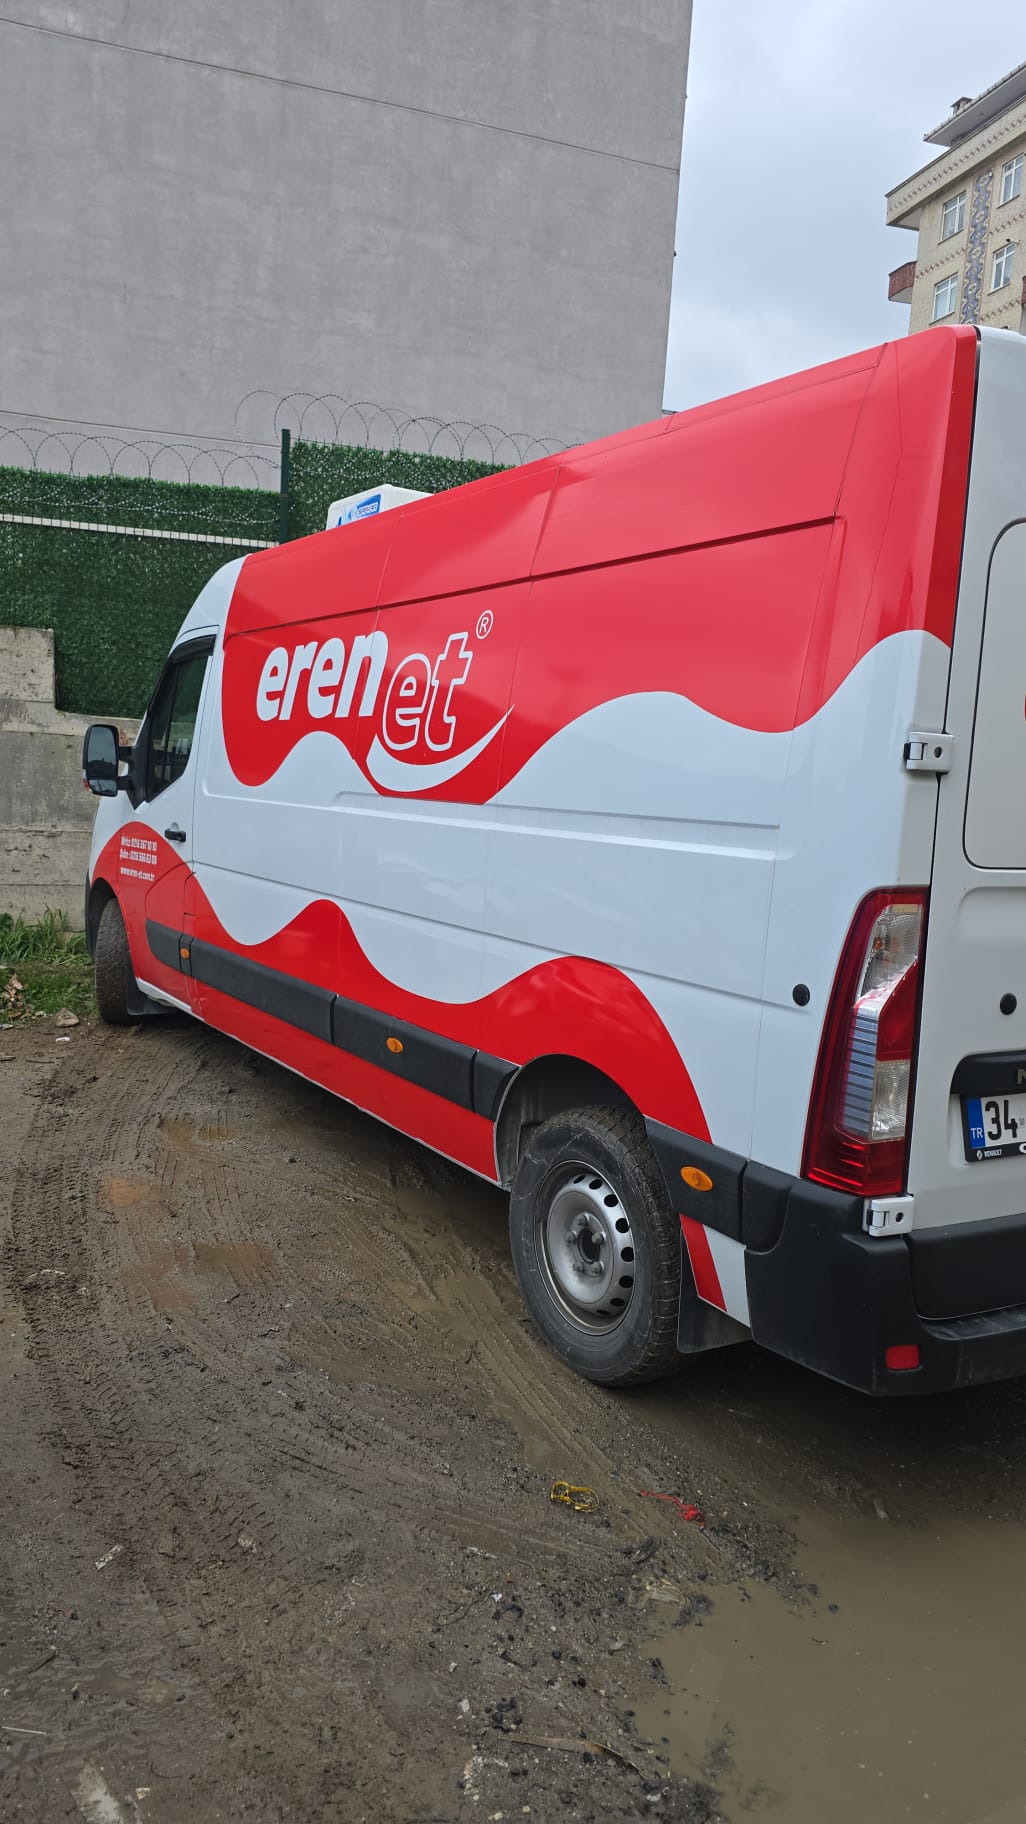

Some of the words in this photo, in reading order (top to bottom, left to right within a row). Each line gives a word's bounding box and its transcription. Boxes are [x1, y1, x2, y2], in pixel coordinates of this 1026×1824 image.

[256, 630, 388, 721] eren
[382, 631, 473, 752] et
[970, 1127, 984, 1140] TR
[985, 1099, 1018, 1141] 34
